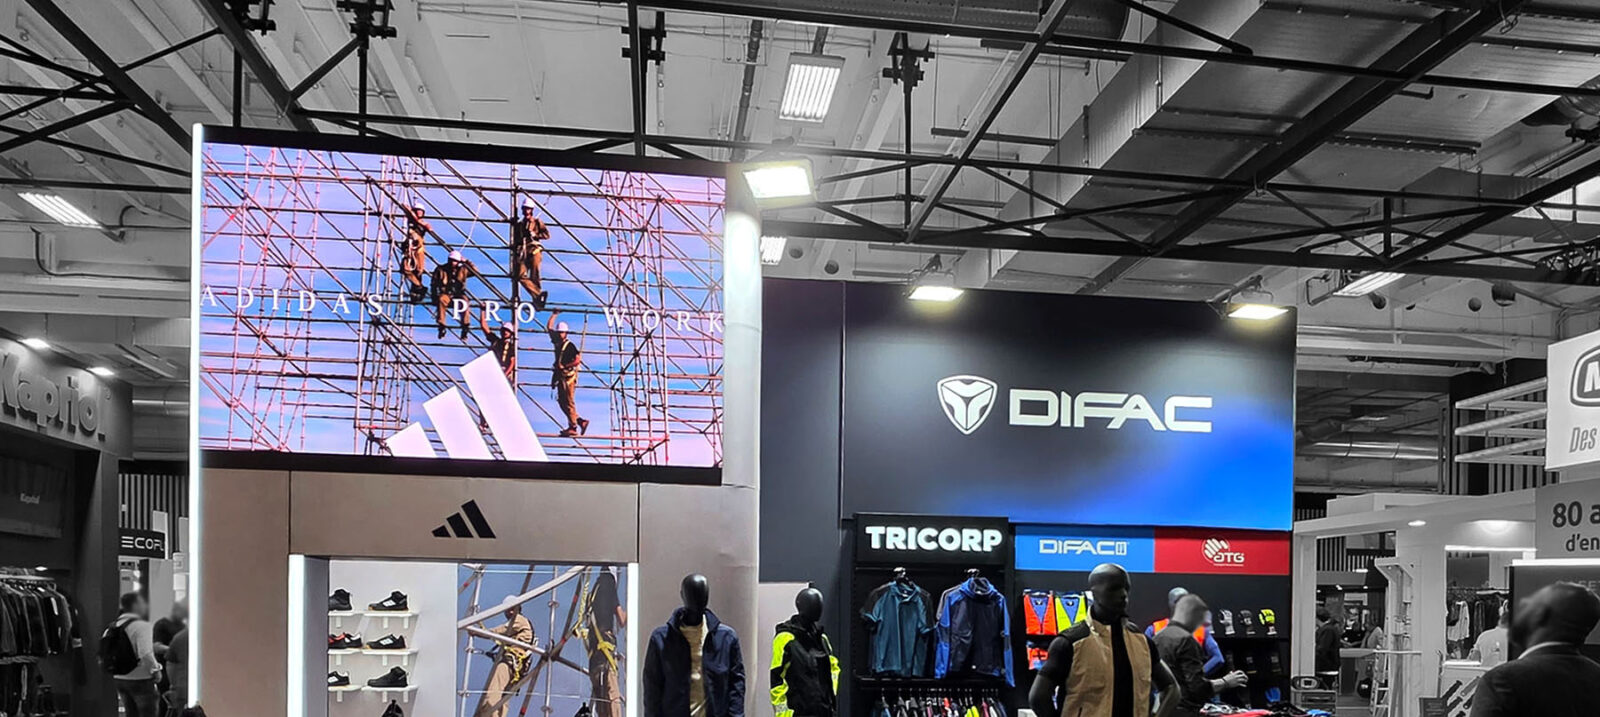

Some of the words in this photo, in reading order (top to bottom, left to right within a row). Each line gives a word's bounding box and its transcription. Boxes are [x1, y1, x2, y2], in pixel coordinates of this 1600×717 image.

[198, 286, 383, 316] ADIDAS
[452, 298, 536, 324] PRO
[602, 307, 724, 333] WORK
[1009, 389, 1213, 433] DIFAC
[1569, 427, 1598, 453] Des
[1552, 501, 1583, 528] 80
[865, 526, 1003, 552] TRICORP
